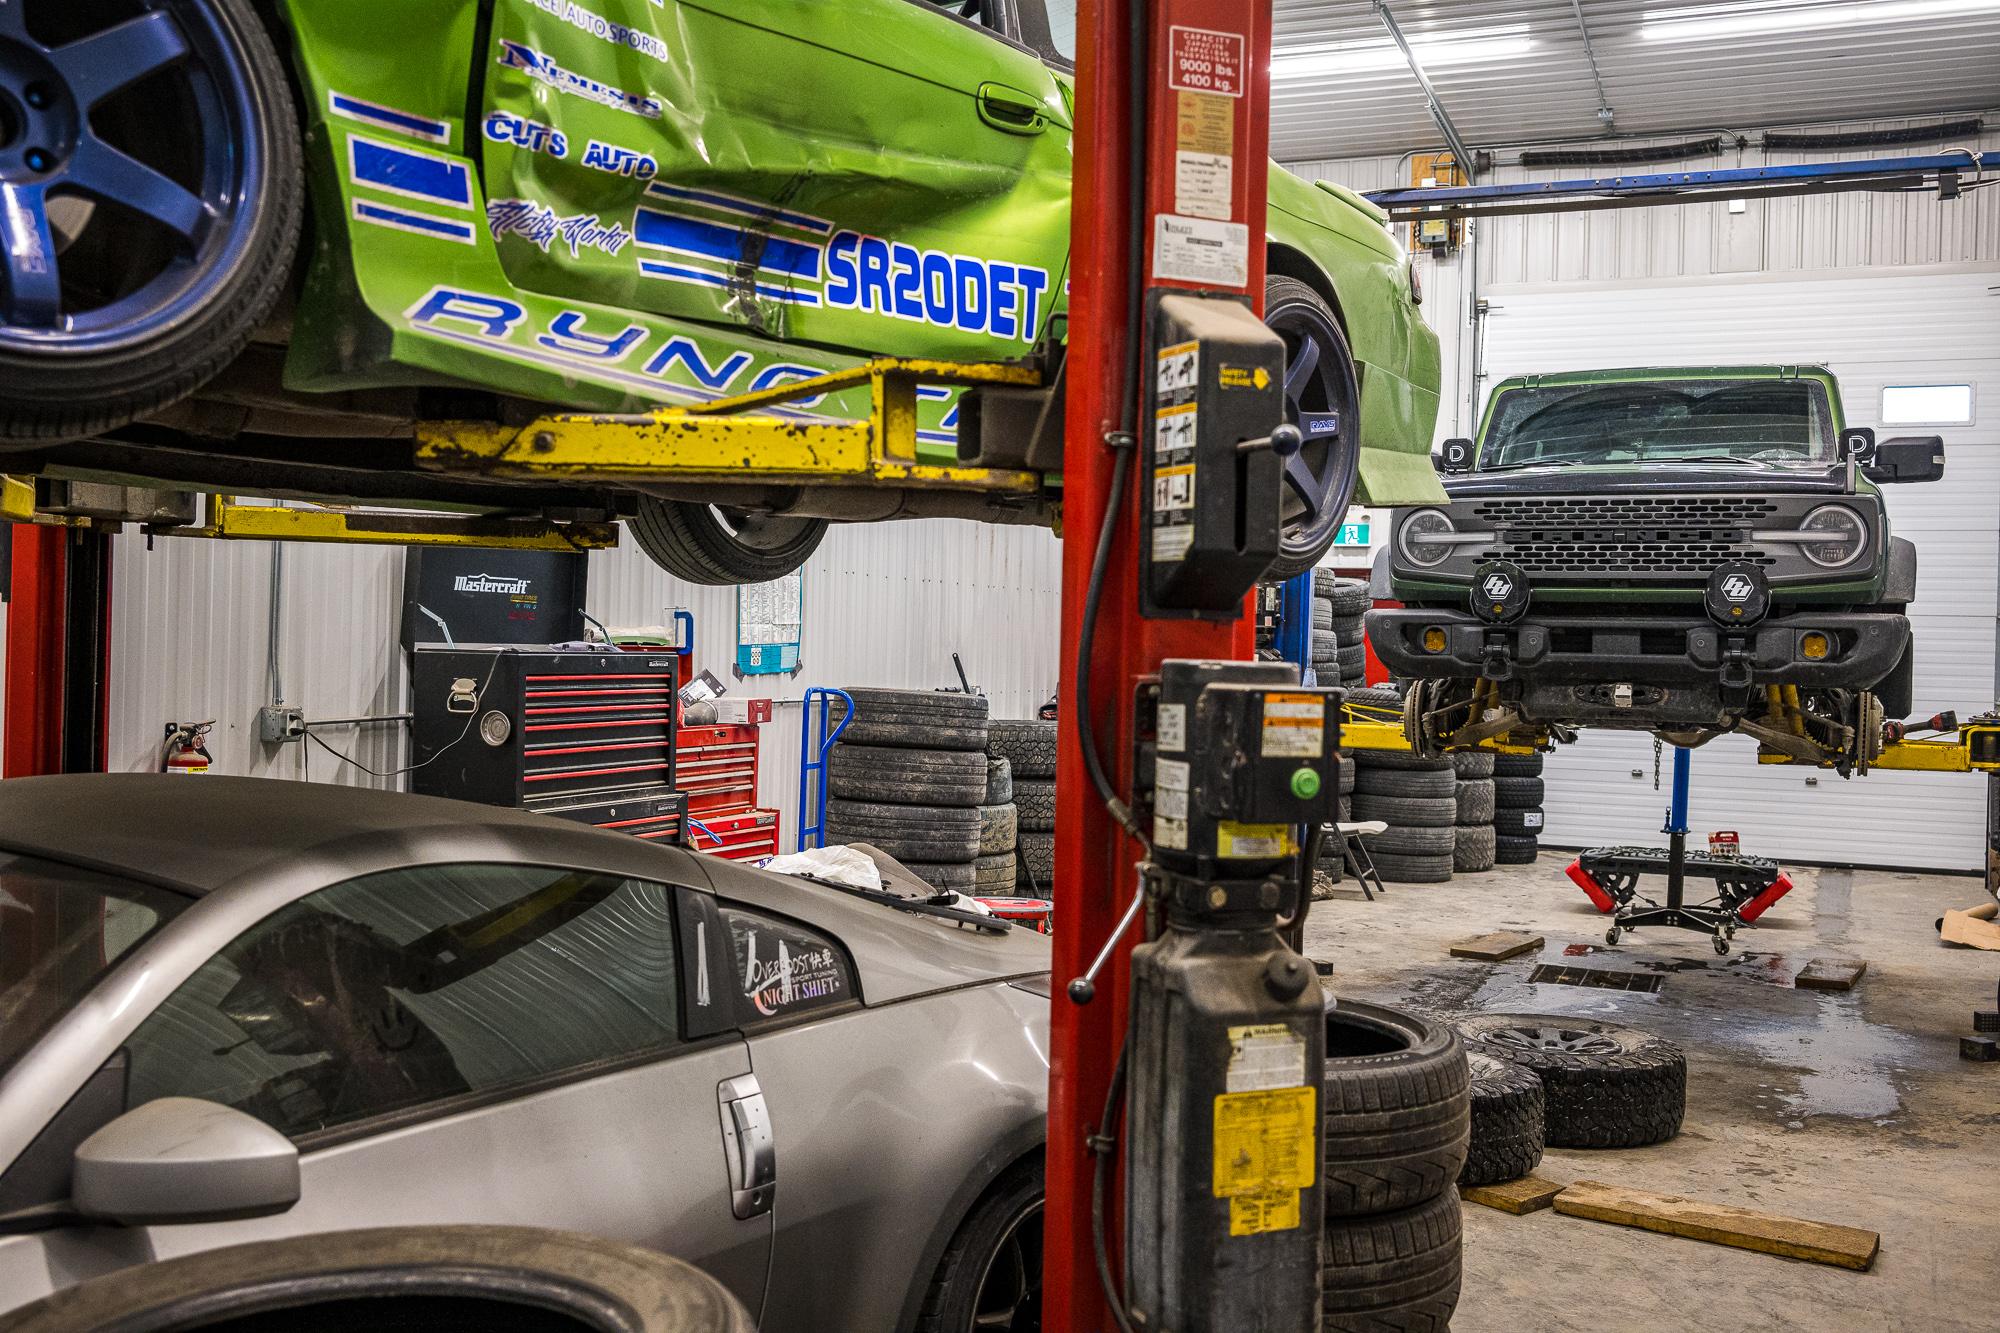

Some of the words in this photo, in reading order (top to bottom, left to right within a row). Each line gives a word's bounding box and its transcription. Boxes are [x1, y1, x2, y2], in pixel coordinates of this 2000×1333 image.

[1183, 31, 1231, 45] CAPACITY
[1180, 58, 1212, 74] 9000
[1215, 63, 1236, 77] lbs.
[1182, 73, 1212, 88] 4100
[1214, 77, 1233, 92] kg.
[484, 111, 568, 158] CUTS
[584, 142, 658, 180] AUTO
[825, 230, 1048, 342] SR20DET
[1310, 420, 1336, 429] RAYS
[453, 575, 528, 595] Mastercraft
[802, 976, 834, 999] SHIFT
